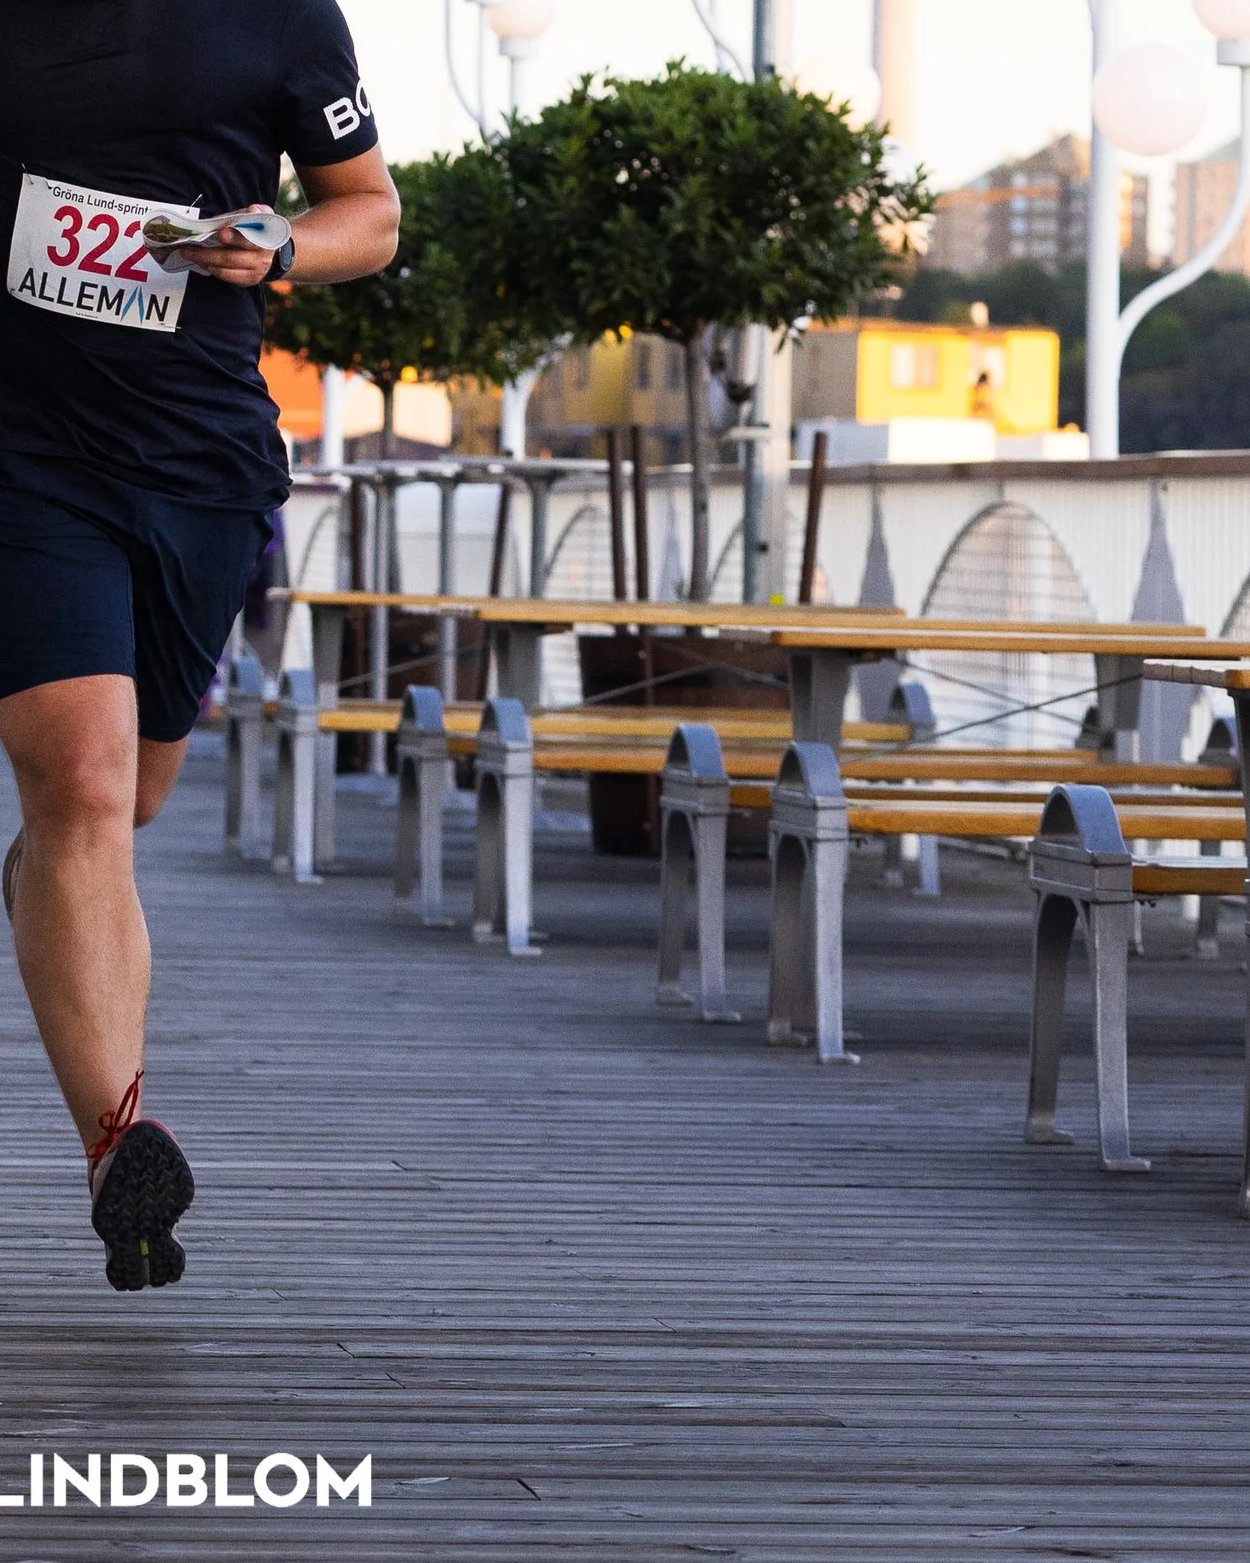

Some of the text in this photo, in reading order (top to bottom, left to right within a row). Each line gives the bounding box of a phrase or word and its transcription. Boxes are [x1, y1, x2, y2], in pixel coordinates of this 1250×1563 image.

[52, 186, 149, 215] Gröna Lund-sprint
[47, 205, 149, 283] 322
[18, 267, 171, 326] ALLEMAN
